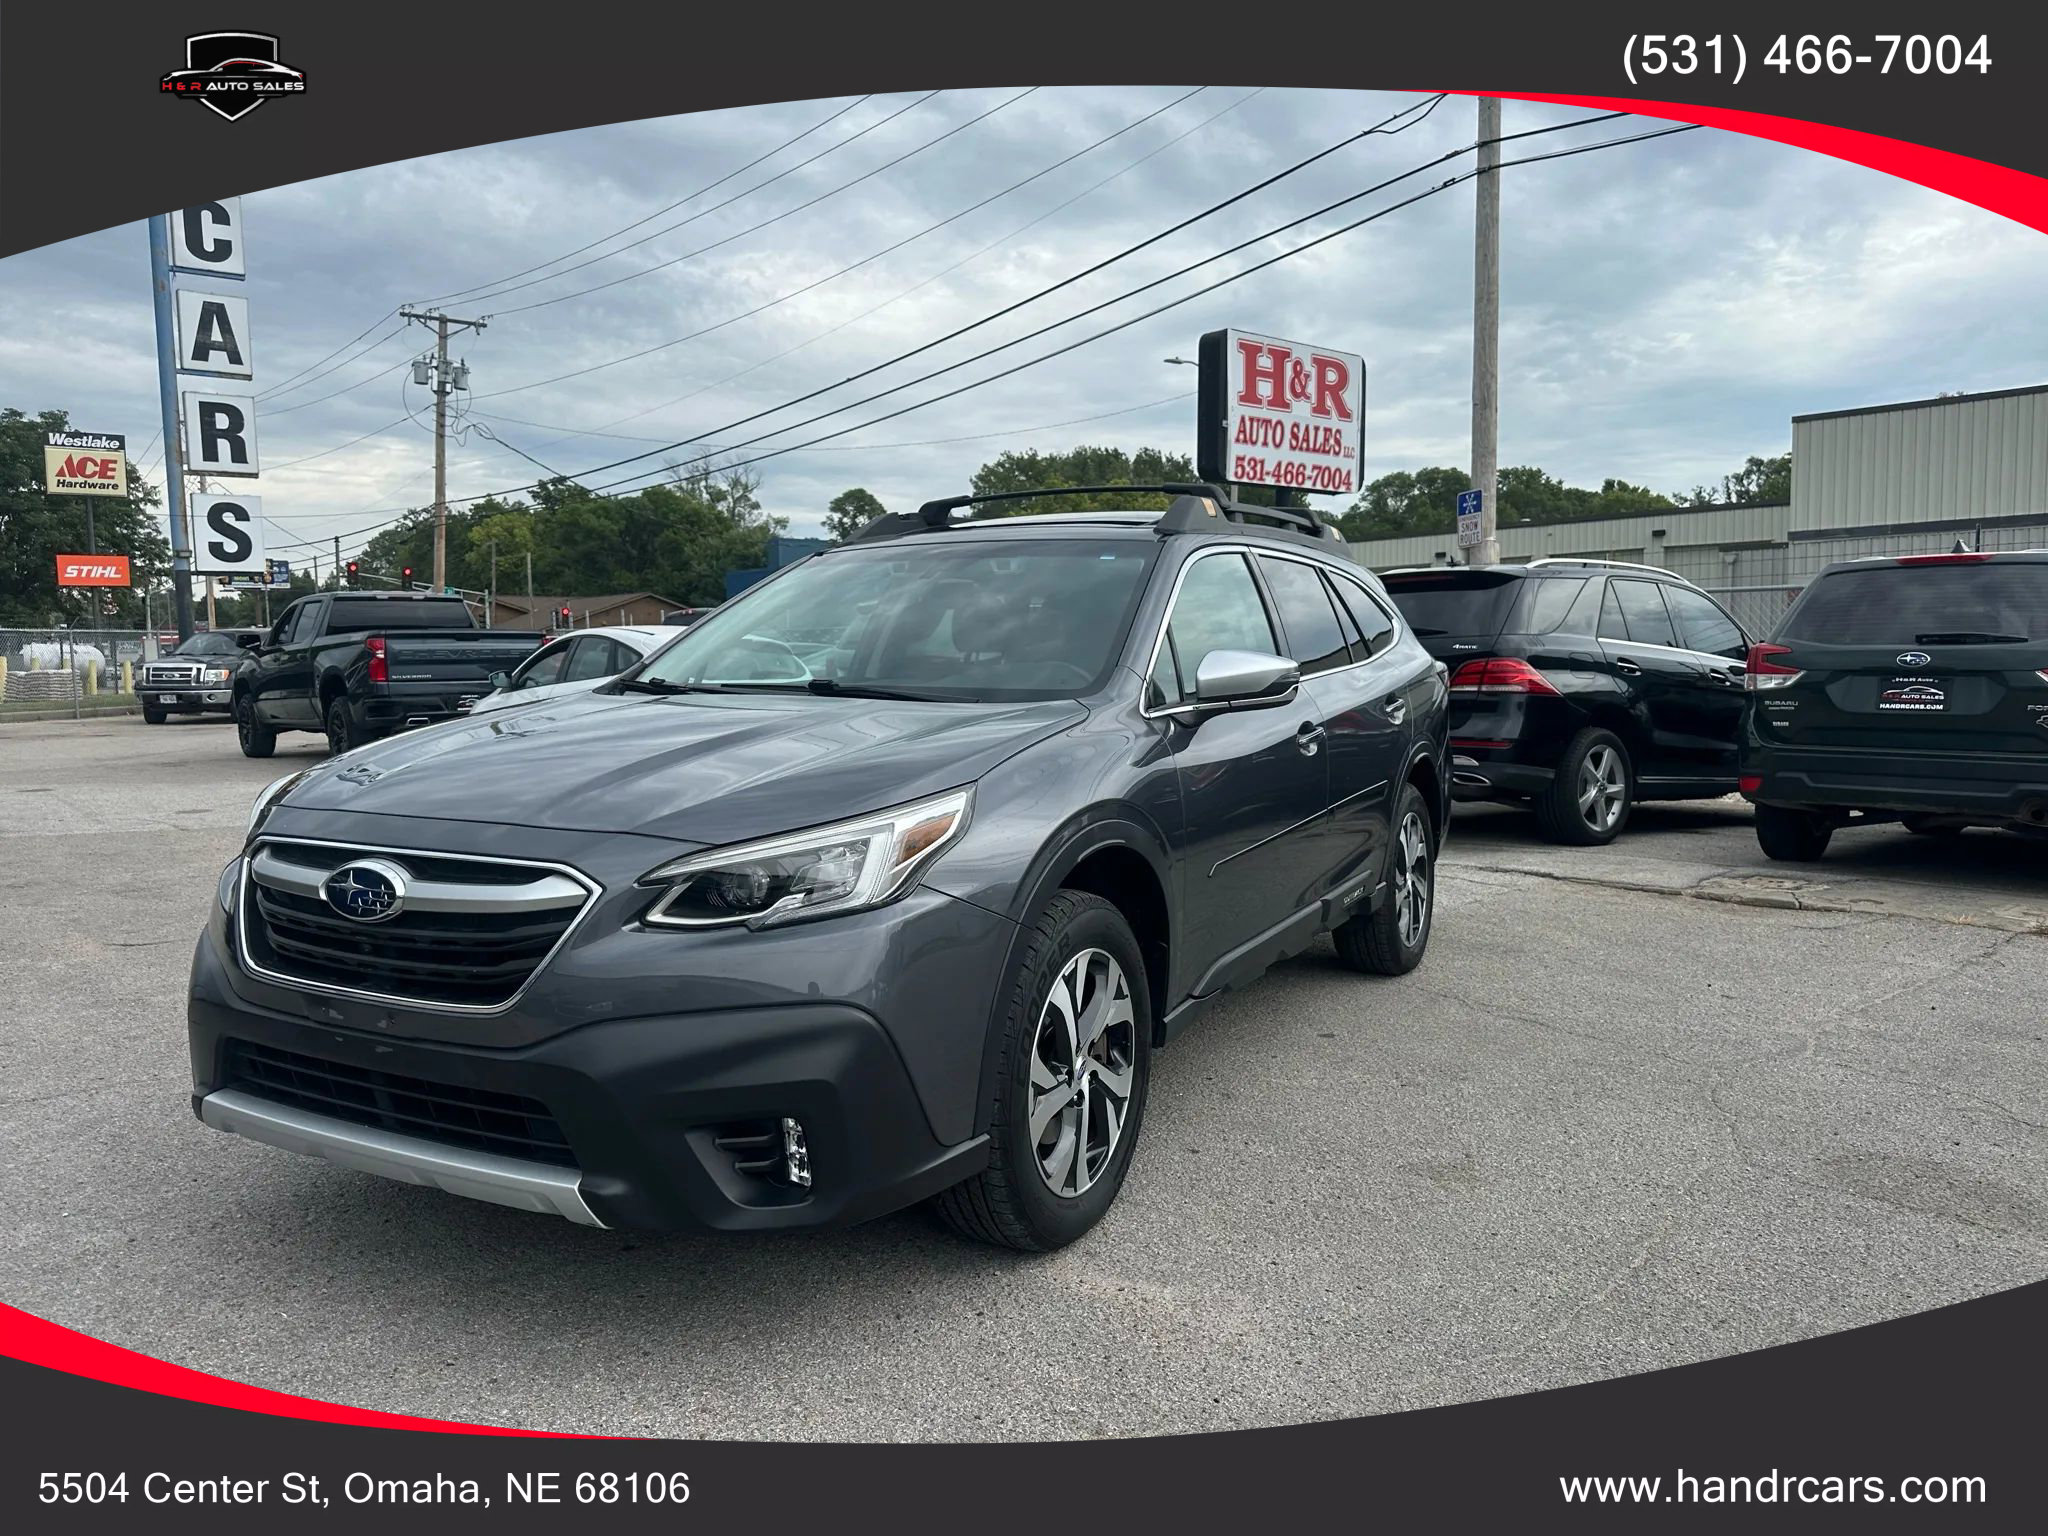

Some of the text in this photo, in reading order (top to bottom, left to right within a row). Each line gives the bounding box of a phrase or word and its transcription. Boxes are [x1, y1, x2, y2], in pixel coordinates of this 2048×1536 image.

[1237, 338, 1353, 422] H&R
[48, 433, 120, 449] Westlake
[1235, 415, 1285, 449] AUTO
[1289, 421, 1342, 457] SALES
[55, 454, 117, 479] ACE
[1234, 455, 1353, 491] 531-466-7004
[56, 479, 119, 490] Hardware
[1461, 520, 1478, 533] SNOW
[1460, 531, 1480, 544] ROUTE
[64, 565, 122, 578] STIHL
